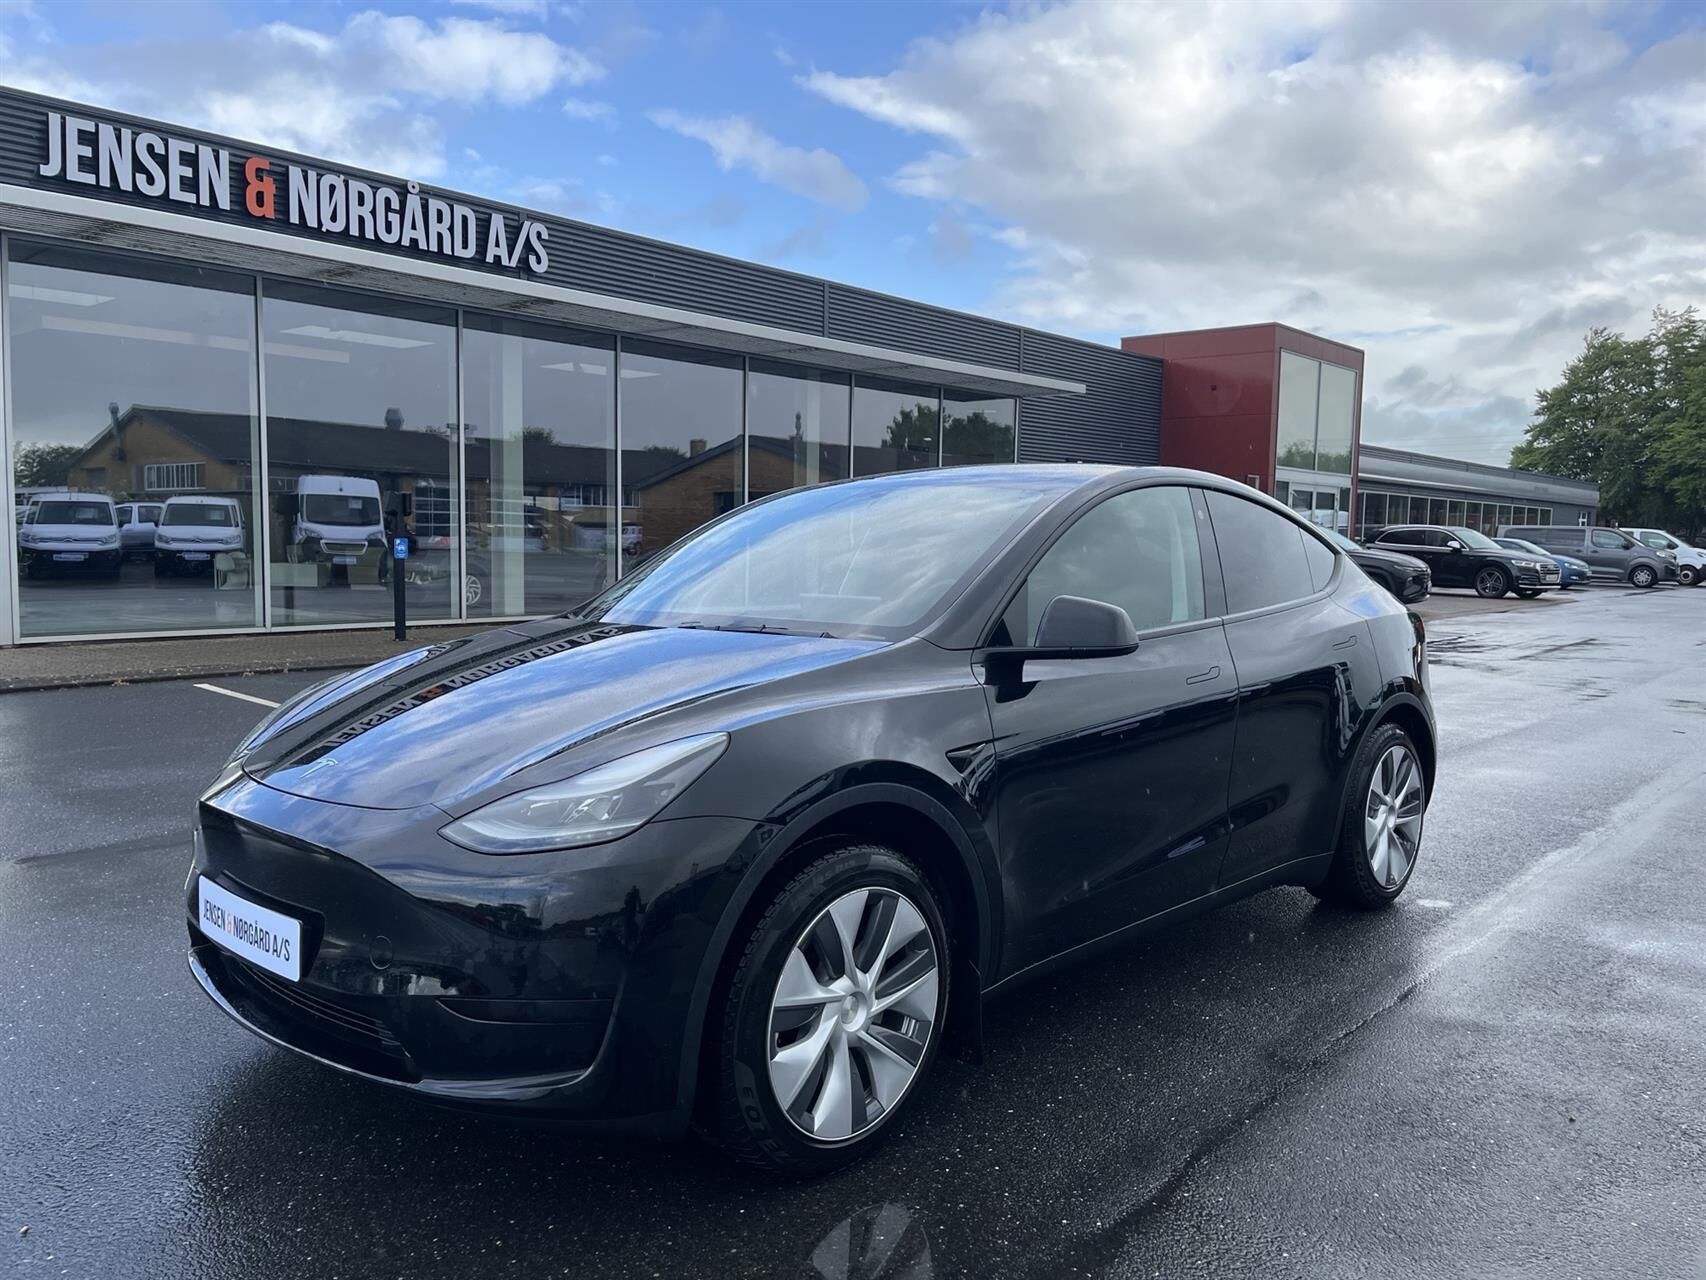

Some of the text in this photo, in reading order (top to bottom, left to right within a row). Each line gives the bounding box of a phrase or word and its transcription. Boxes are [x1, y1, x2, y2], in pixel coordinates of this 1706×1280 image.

[40, 112, 549, 273] JENSEN & NØRGÅRD A/S
[203, 898, 290, 962] JENSEN & NØRGÅRD A/S
